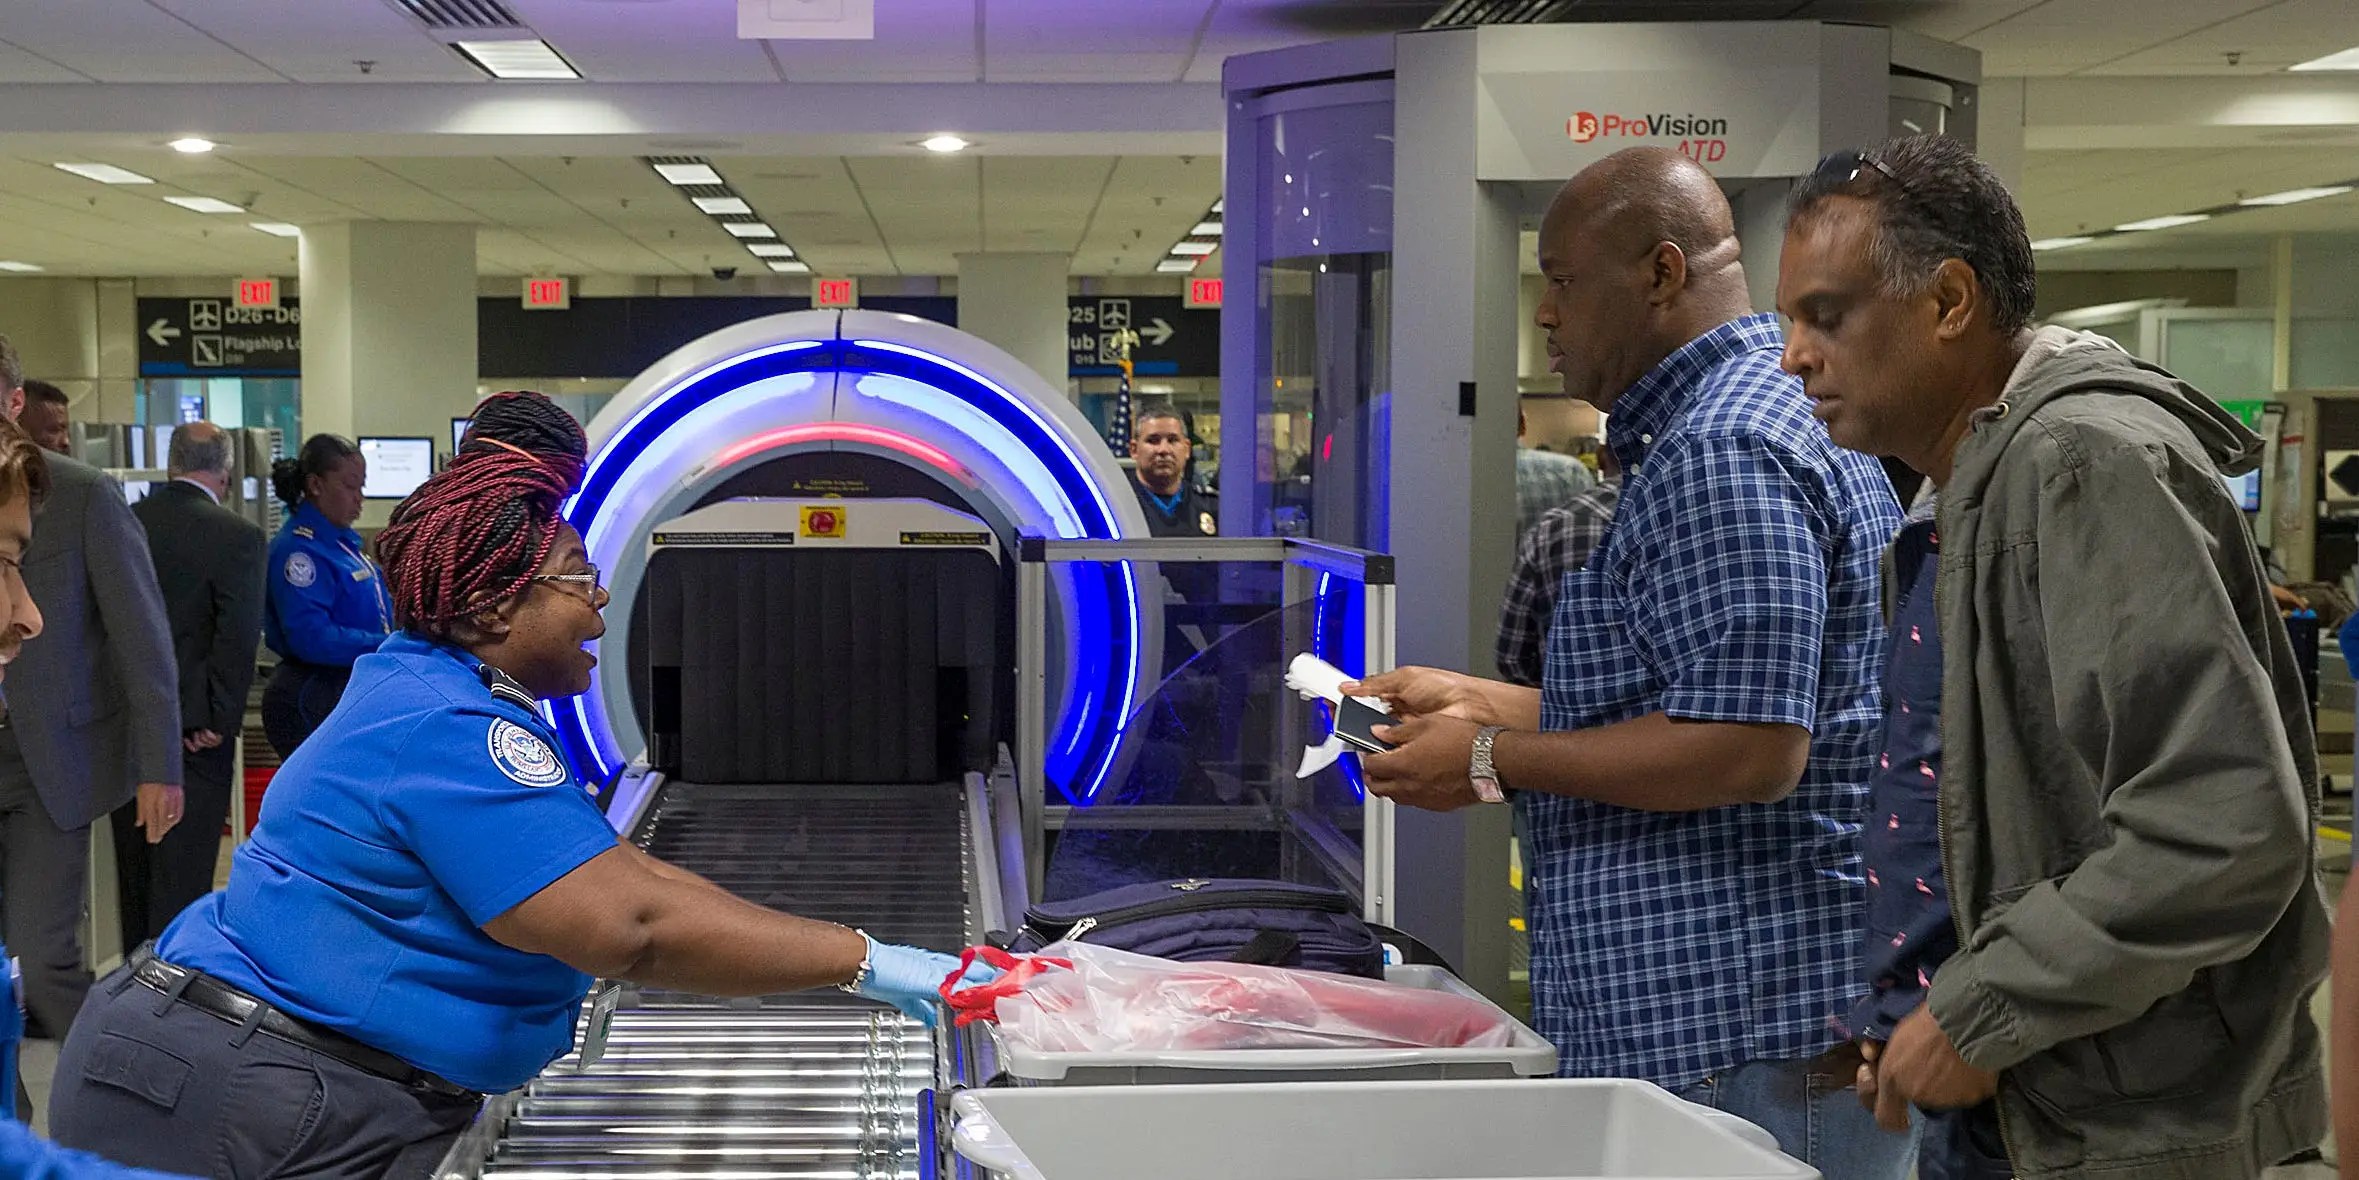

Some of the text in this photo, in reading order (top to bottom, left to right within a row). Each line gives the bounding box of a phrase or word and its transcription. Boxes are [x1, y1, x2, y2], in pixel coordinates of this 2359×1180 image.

[1602, 113, 1727, 137] ProVision
[241, 280, 272, 305] EXIT
[530, 279, 562, 304] EXIT
[819, 280, 851, 304] EXIT
[1068, 306, 1096, 323] 25
[225, 336, 284, 353] Flagship
